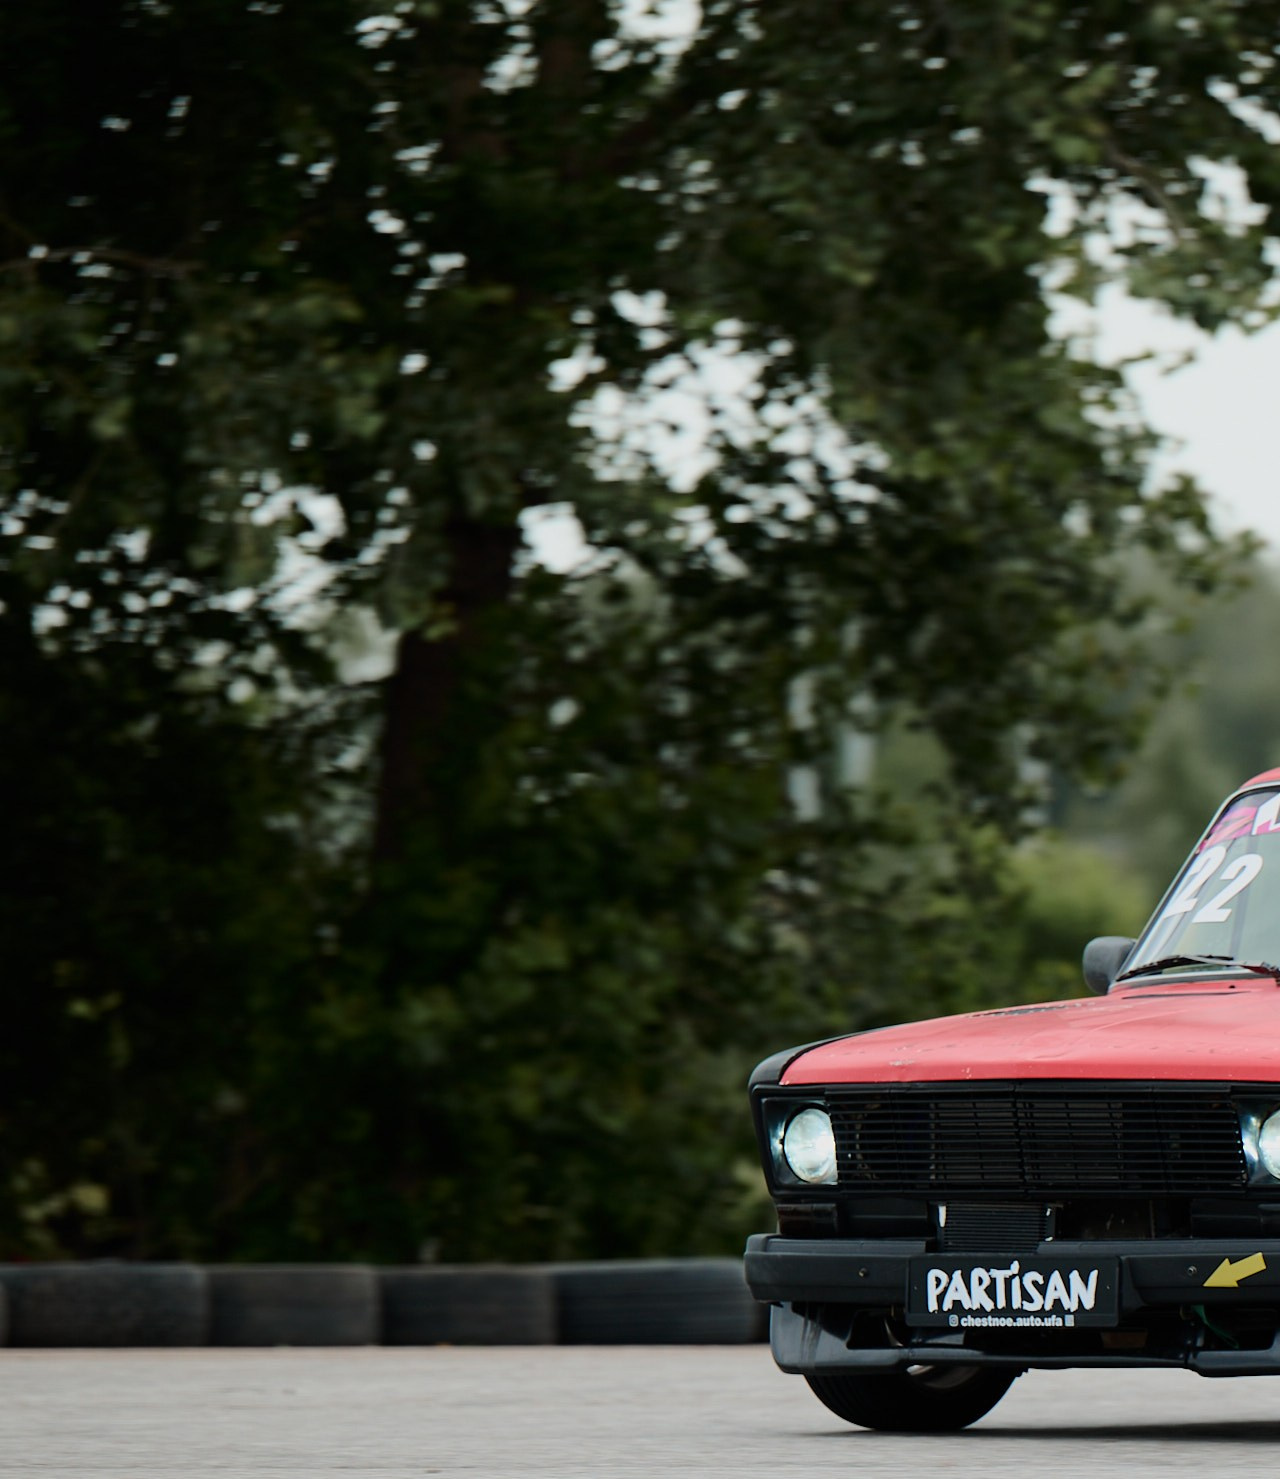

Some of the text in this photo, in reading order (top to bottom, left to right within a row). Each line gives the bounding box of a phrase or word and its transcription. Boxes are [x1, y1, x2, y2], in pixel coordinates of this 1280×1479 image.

[1162, 845, 1263, 924] 22
[927, 1260, 1098, 1313] PARTISAN
[960, 1314, 1063, 1327] chestnoe.auto.ufa
